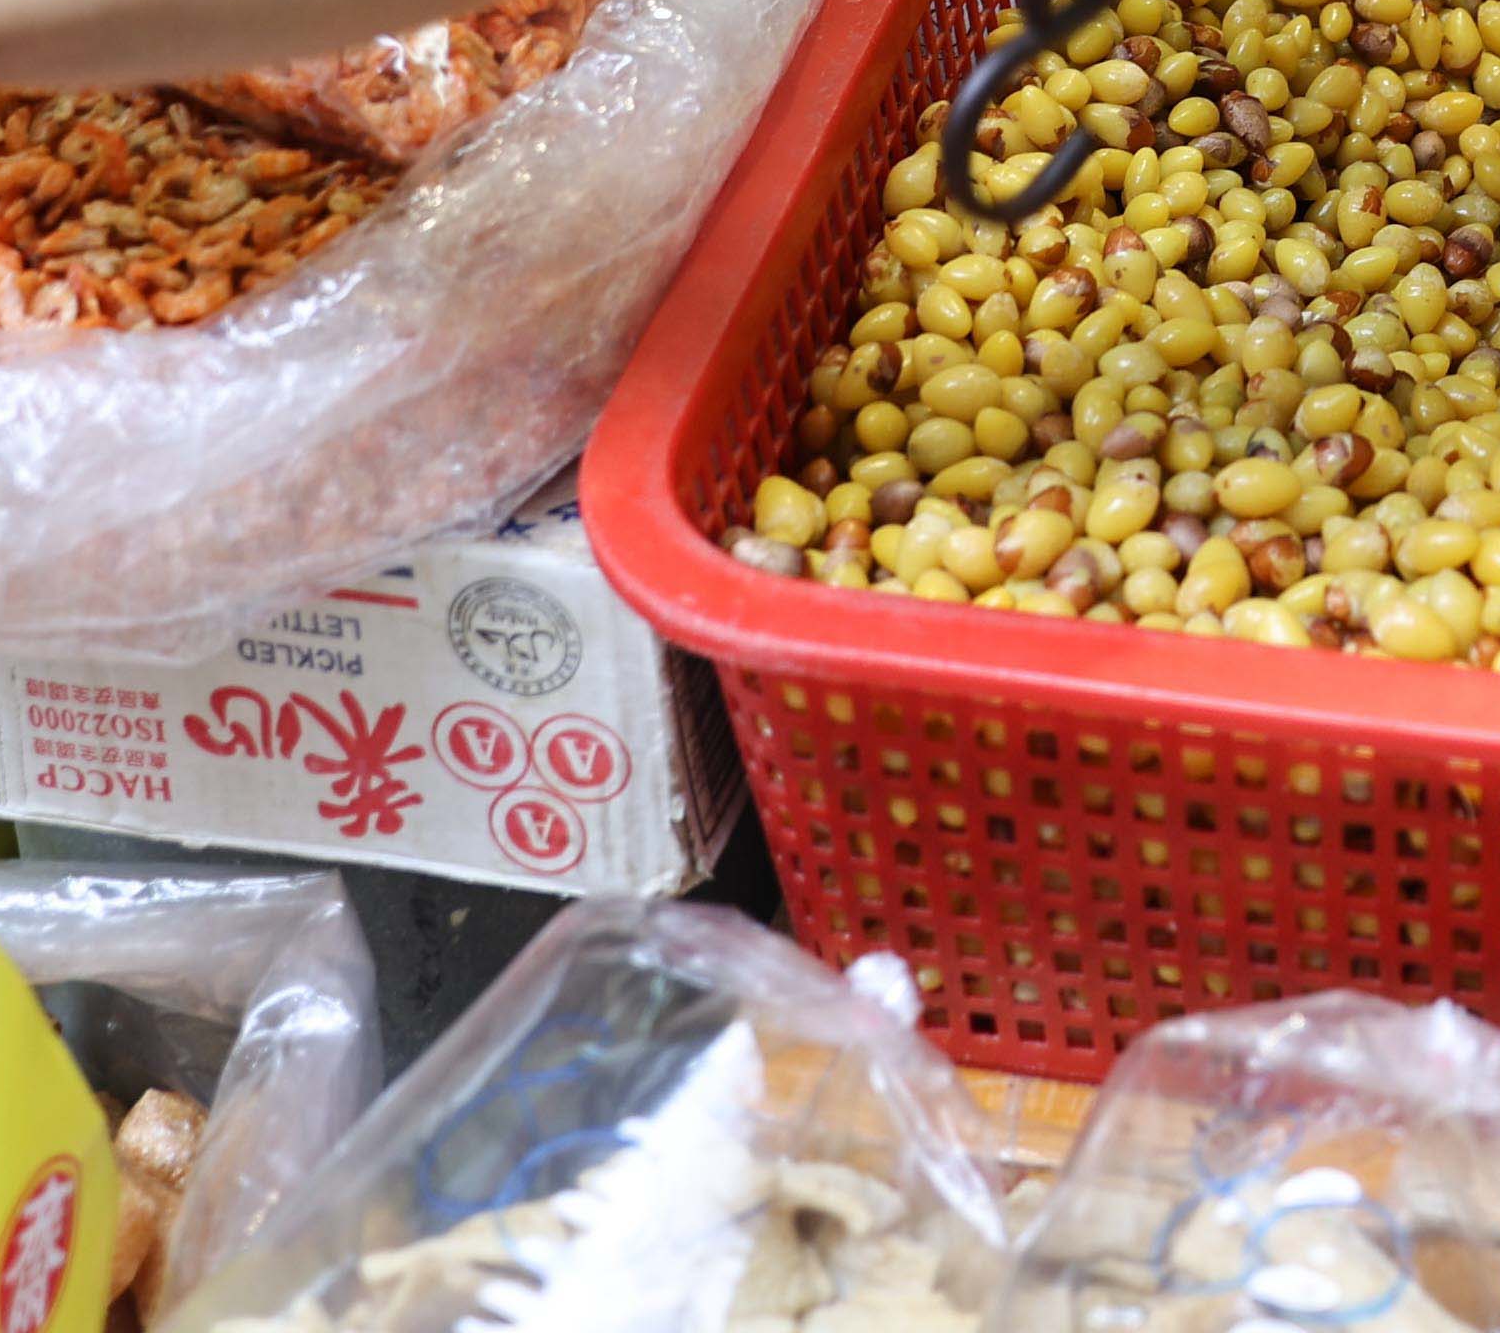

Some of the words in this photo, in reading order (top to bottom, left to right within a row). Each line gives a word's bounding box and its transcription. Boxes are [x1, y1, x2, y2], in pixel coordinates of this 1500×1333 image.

[235, 635, 364, 677] PICKLED
[27, 704, 166, 743] ISO22000
[181, 683, 424, 838] 菜心
[37, 762, 172, 802] HACCP
